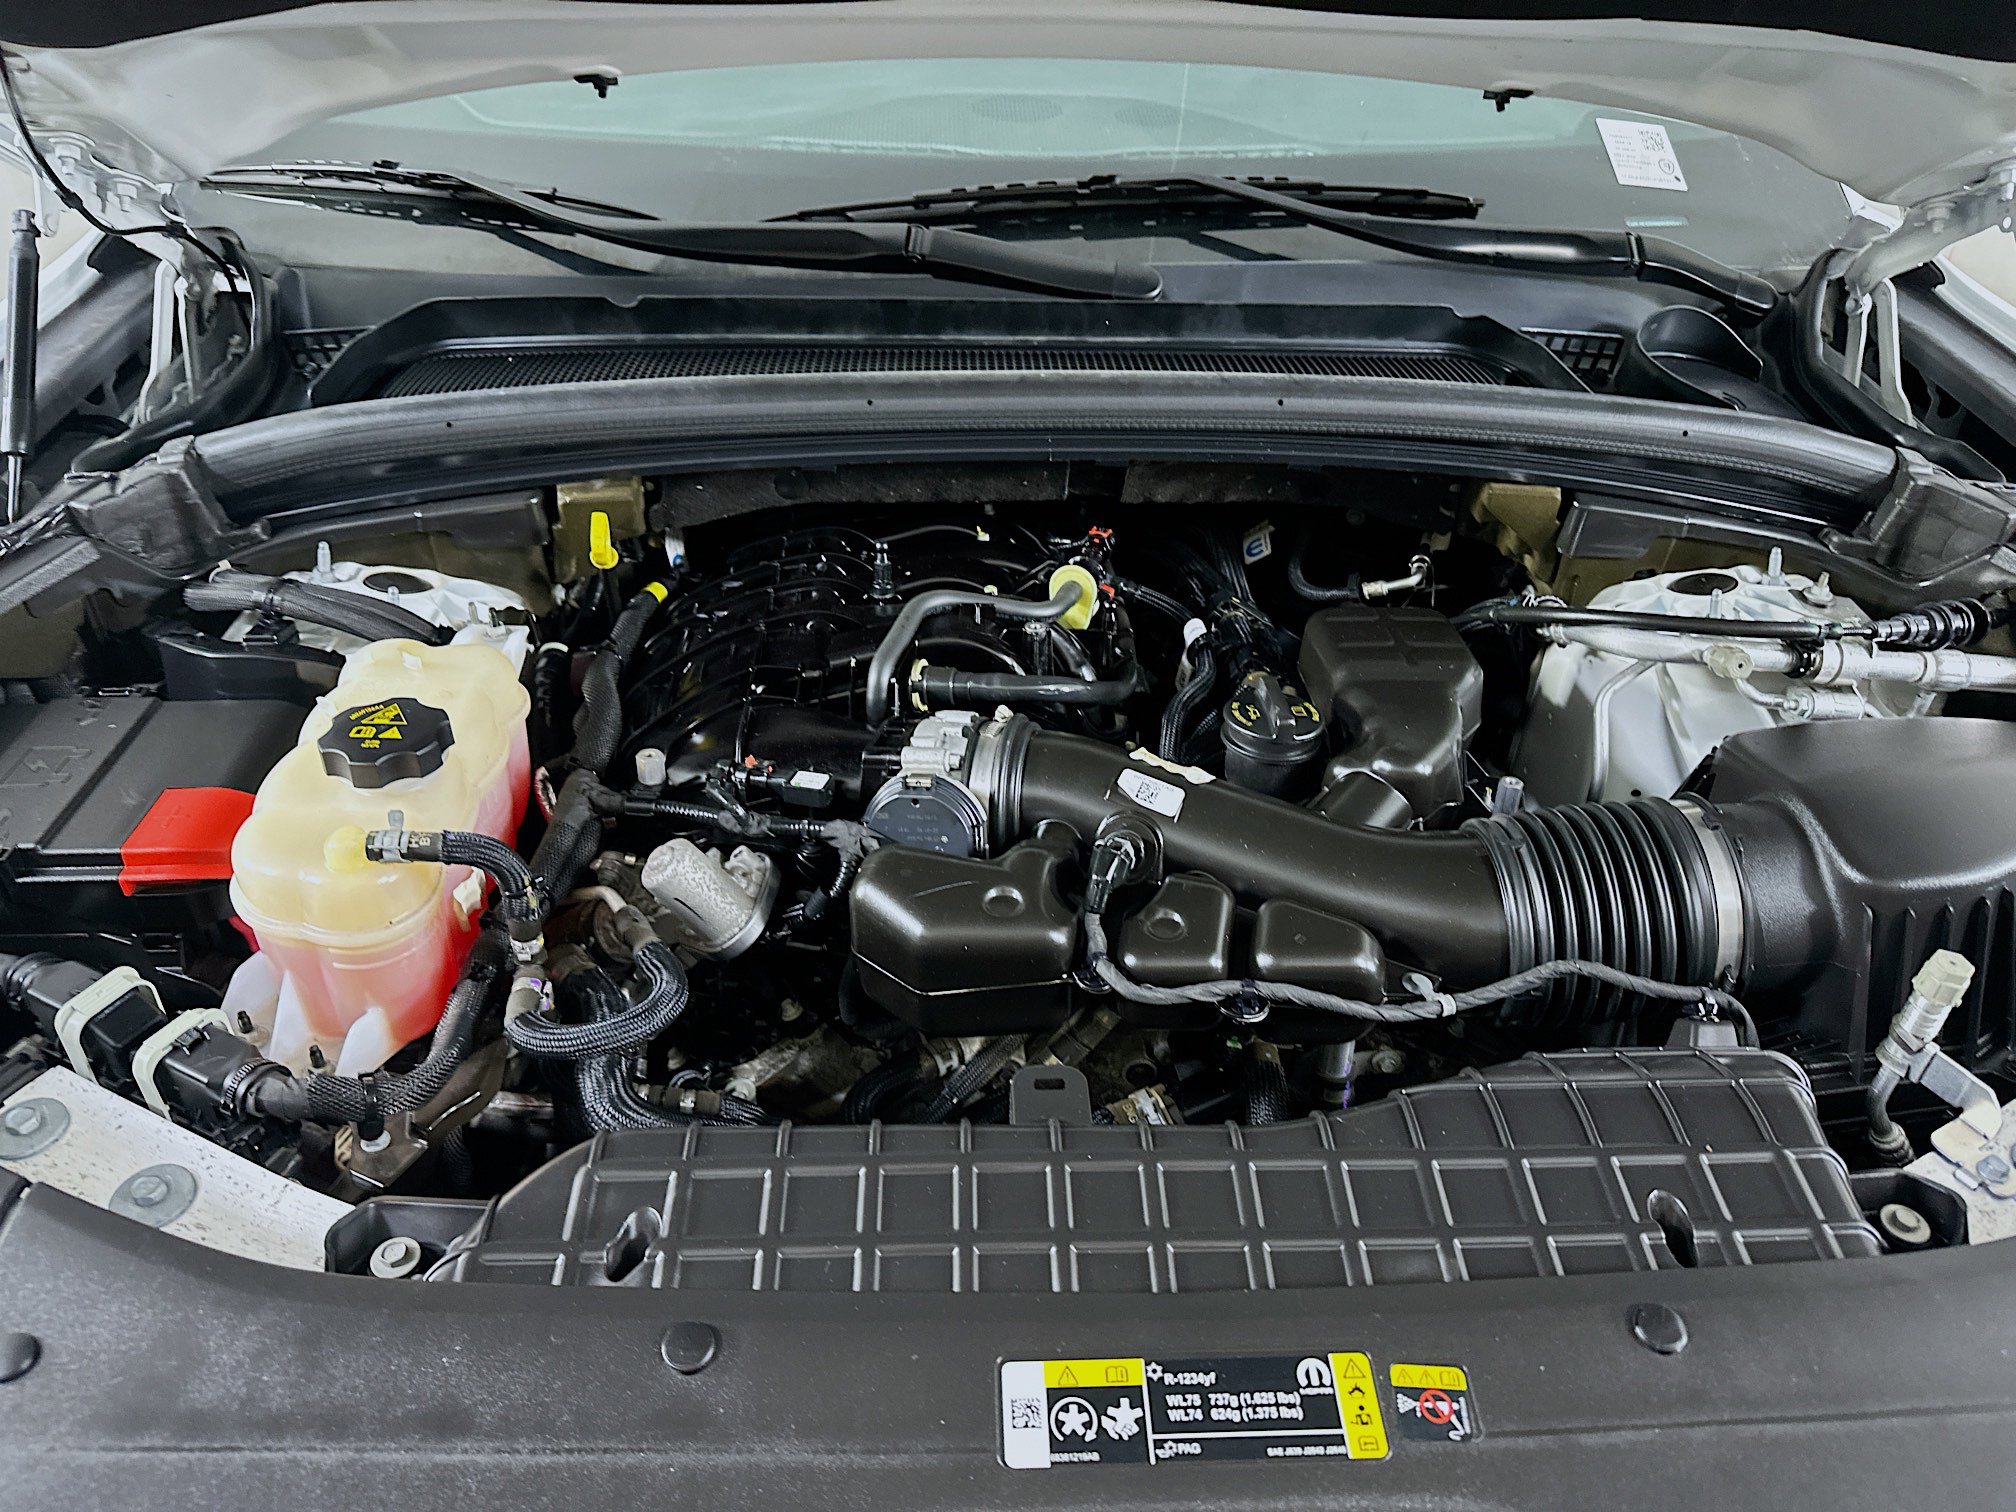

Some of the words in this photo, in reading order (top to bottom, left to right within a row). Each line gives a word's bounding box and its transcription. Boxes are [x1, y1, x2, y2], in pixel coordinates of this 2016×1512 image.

[1163, 1371, 1217, 1387] R-1234yf
[1207, 1393, 1239, 1408] 737g
[1239, 1391, 1276, 1407] (1.625
[1276, 1391, 1301, 1406] lbs)
[1166, 1408, 1204, 1422] WL74
[1210, 1407, 1241, 1423] 624g
[1241, 1406, 1279, 1423] (1.375
[1278, 1405, 1304, 1421] lbs)
[1177, 1442, 1202, 1455] PAG
